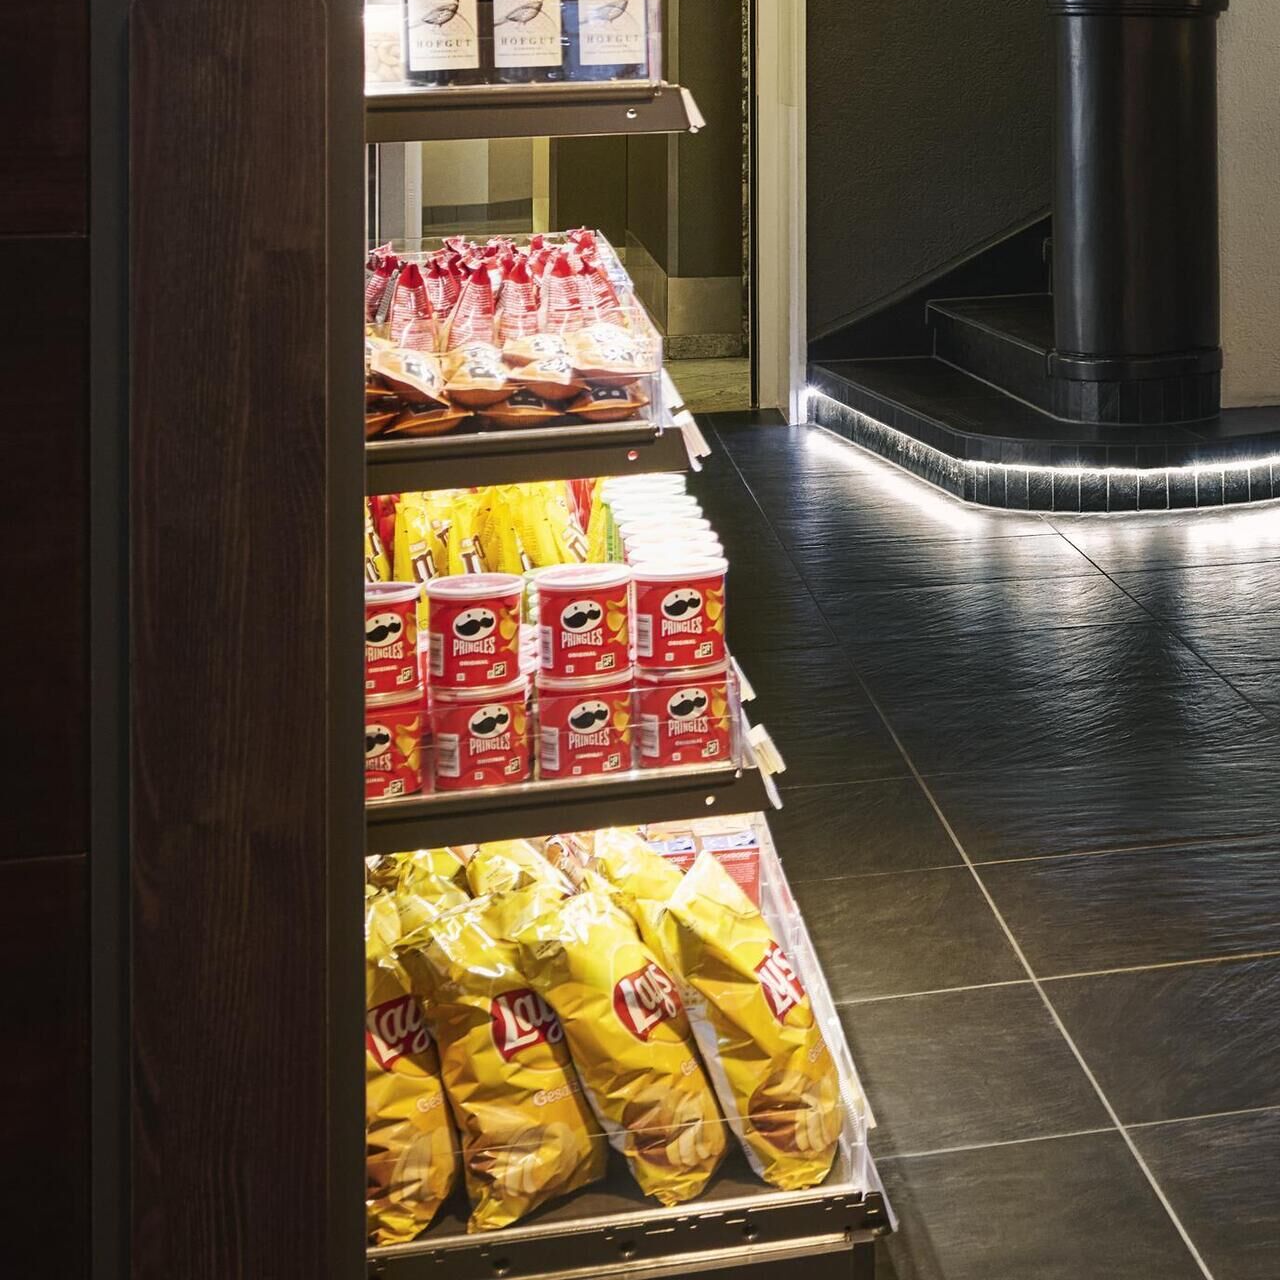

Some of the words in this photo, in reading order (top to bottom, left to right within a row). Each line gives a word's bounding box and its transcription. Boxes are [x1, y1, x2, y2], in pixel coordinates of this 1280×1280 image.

[416, 38, 472, 49] HOFGUT
[500, 36, 556, 47] HOFGUT
[585, 33, 640, 45] HOFGUT
[660, 616, 703, 637] PRINGLES
[452, 636, 496, 657] PRINGLES
[560, 629, 604, 649] PRINGLES
[667, 715, 709, 737] PRINGLES
[469, 732, 511, 757] PRINGLES
[568, 727, 610, 751] PRINGLES
